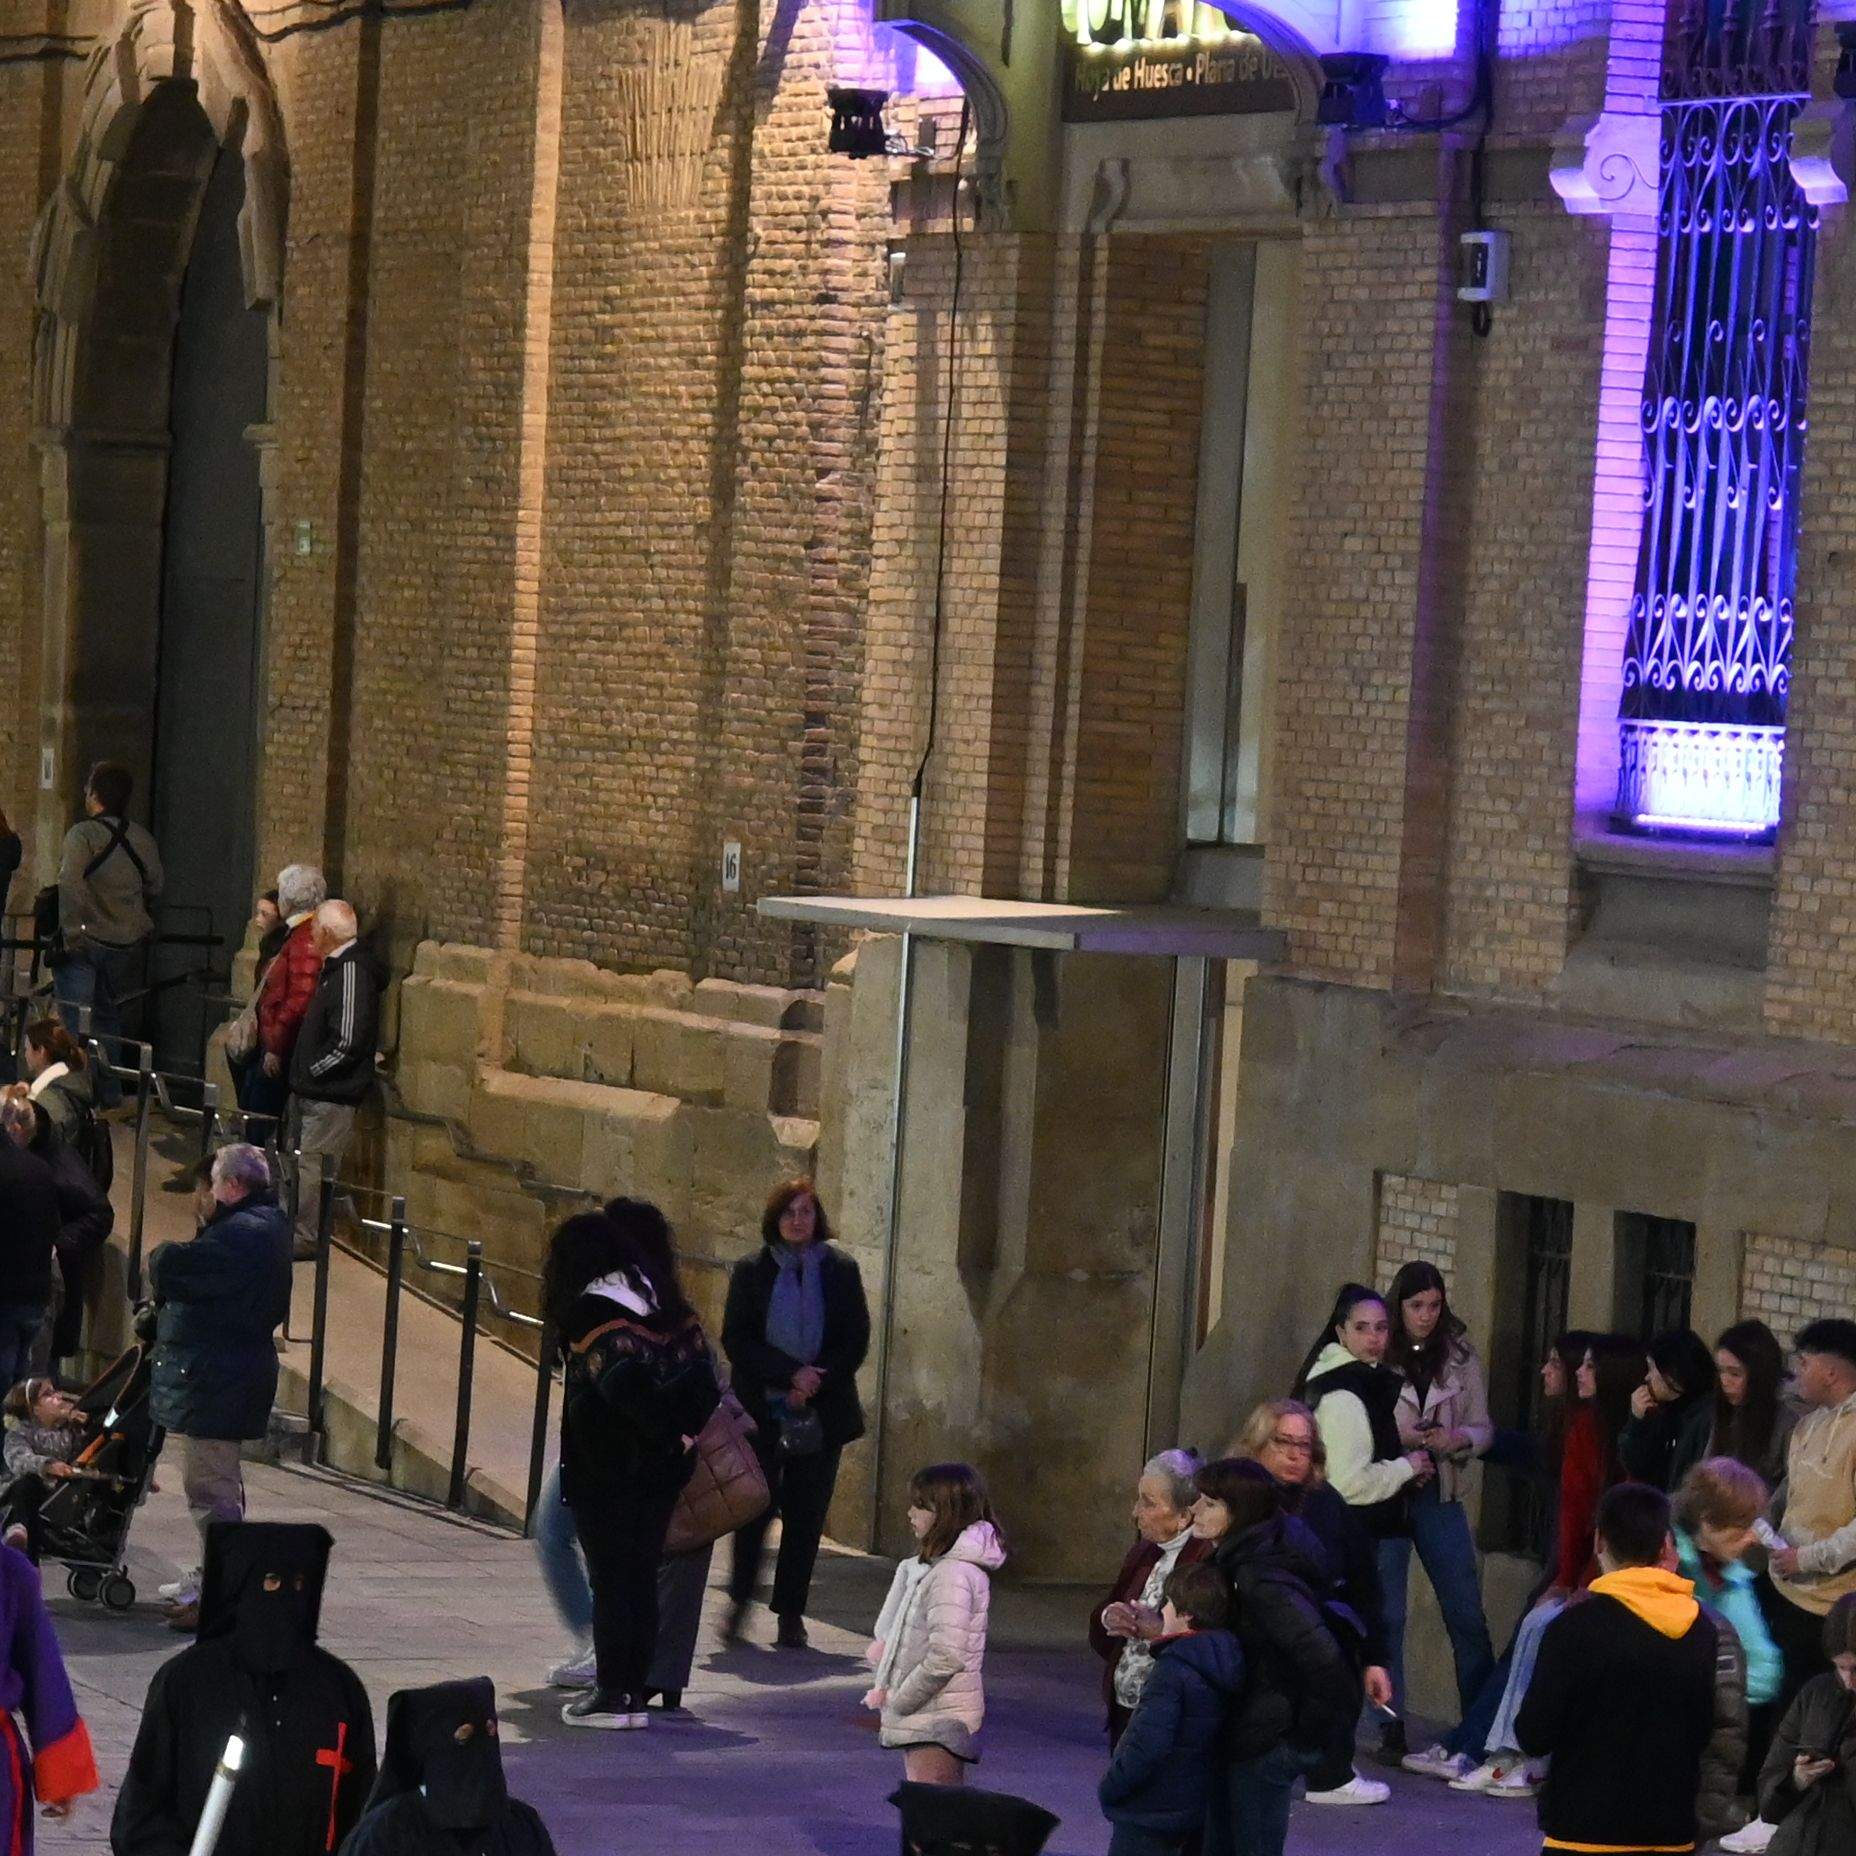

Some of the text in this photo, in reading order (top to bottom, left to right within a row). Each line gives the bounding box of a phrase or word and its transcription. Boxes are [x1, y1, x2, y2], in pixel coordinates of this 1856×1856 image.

[1134, 56, 1183, 90] Huesca
[1195, 51, 1236, 84] Plana
[726, 852, 736, 880] 16
